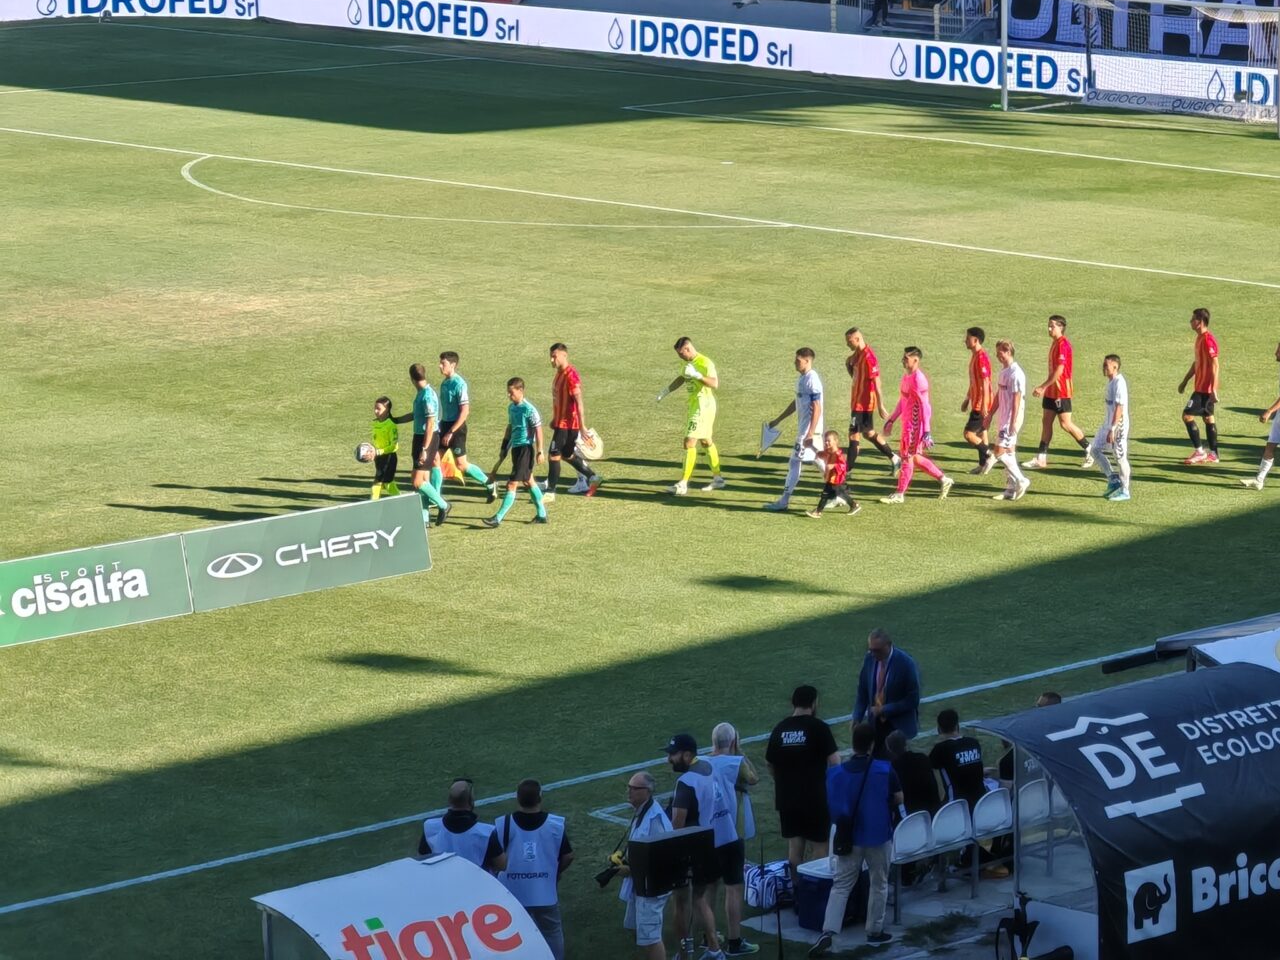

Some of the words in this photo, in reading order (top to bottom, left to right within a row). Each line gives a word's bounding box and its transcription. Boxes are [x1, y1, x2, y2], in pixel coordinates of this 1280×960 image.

[495, 18, 519, 41] Srl
[630, 19, 759, 62] IDROFED
[766, 41, 792, 67] Srl
[914, 44, 1058, 89] IDROFED
[1066, 67, 1096, 93] Srl
[1087, 90, 1147, 106] QUIGIOCO
[1172, 98, 1232, 114] QUIGIOCO
[275, 526, 402, 567] CHERY
[11, 568, 149, 618] cisalfa
[43, 561, 121, 582] SPORT
[1078, 730, 1181, 790] DE
[340, 904, 523, 960] tigre
